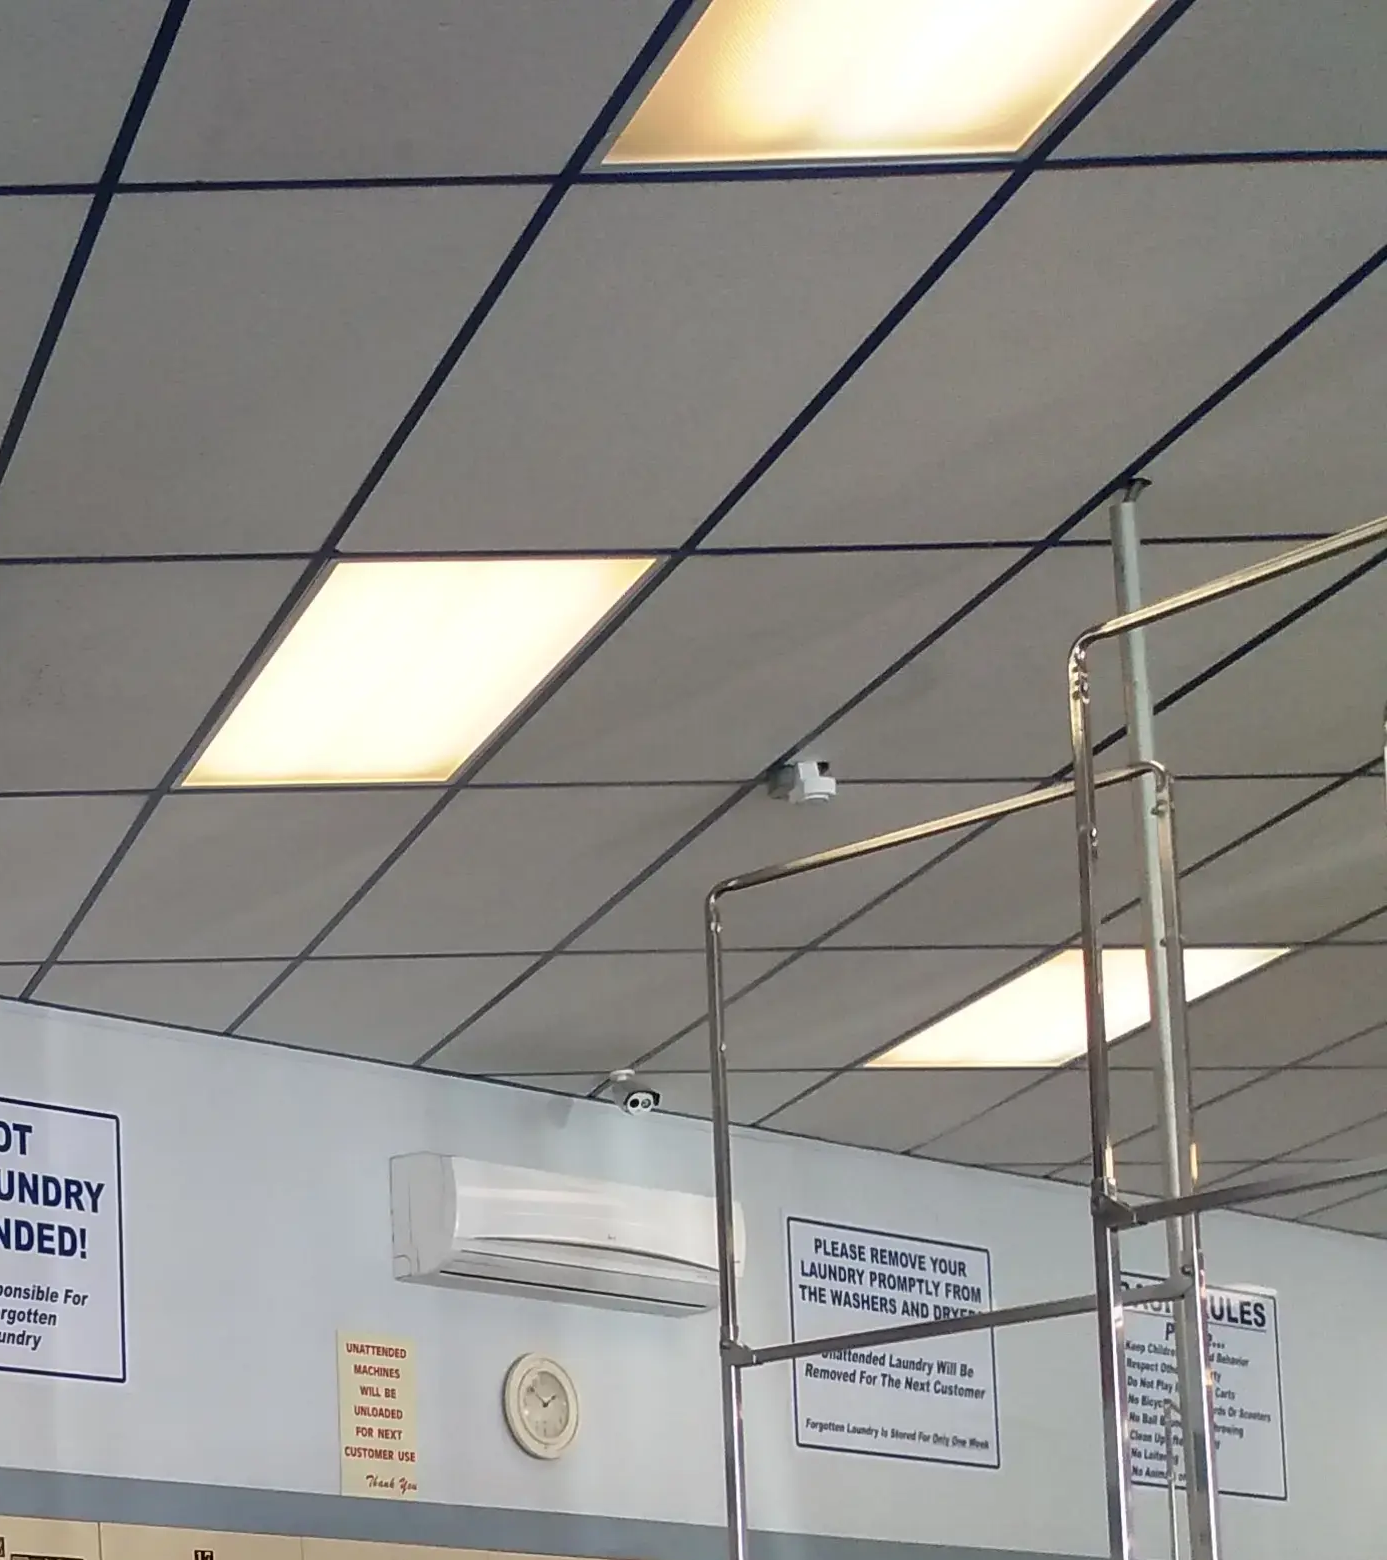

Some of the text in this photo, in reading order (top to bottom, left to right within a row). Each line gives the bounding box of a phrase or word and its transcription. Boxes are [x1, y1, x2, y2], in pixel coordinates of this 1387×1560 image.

[814, 1238, 967, 1278] PLEASE REMOVE YOUR
[800, 1260, 981, 1303] LAUNDRY PROMPTLY FROM
[63, 1289, 88, 1307] For
[799, 1284, 982, 1320] THE WASHERS AND DRYE
[1206, 1295, 1266, 1328] ULES
[346, 1342, 407, 1359] UNATTENDED
[354, 1364, 400, 1379] MACHINES
[889, 1353, 933, 1376] Laundry
[936, 1360, 958, 1377] Will
[960, 1363, 974, 1378] Be
[805, 1363, 985, 1400] Removed For The Next Customer
[1140, 1377, 1154, 1389] Not
[1156, 1379, 1172, 1393] Play
[360, 1385, 396, 1399] WILL BE
[1215, 1387, 1235, 1400] Carts
[354, 1405, 403, 1420] UNLOADED
[355, 1426, 403, 1440] FOR NEXT
[805, 1417, 844, 1433] Forgotten
[847, 1423, 879, 1439] Laundry
[880, 1428, 888, 1438] Is
[891, 1428, 916, 1441] Stored
[918, 1431, 931, 1443] For
[932, 1433, 950, 1447] Only
[951, 1435, 967, 1446] One
[1130, 1430, 1152, 1443] Clean
[344, 1446, 416, 1462] CUSTOMER USE
[366, 1474, 418, 1495] Thank You
